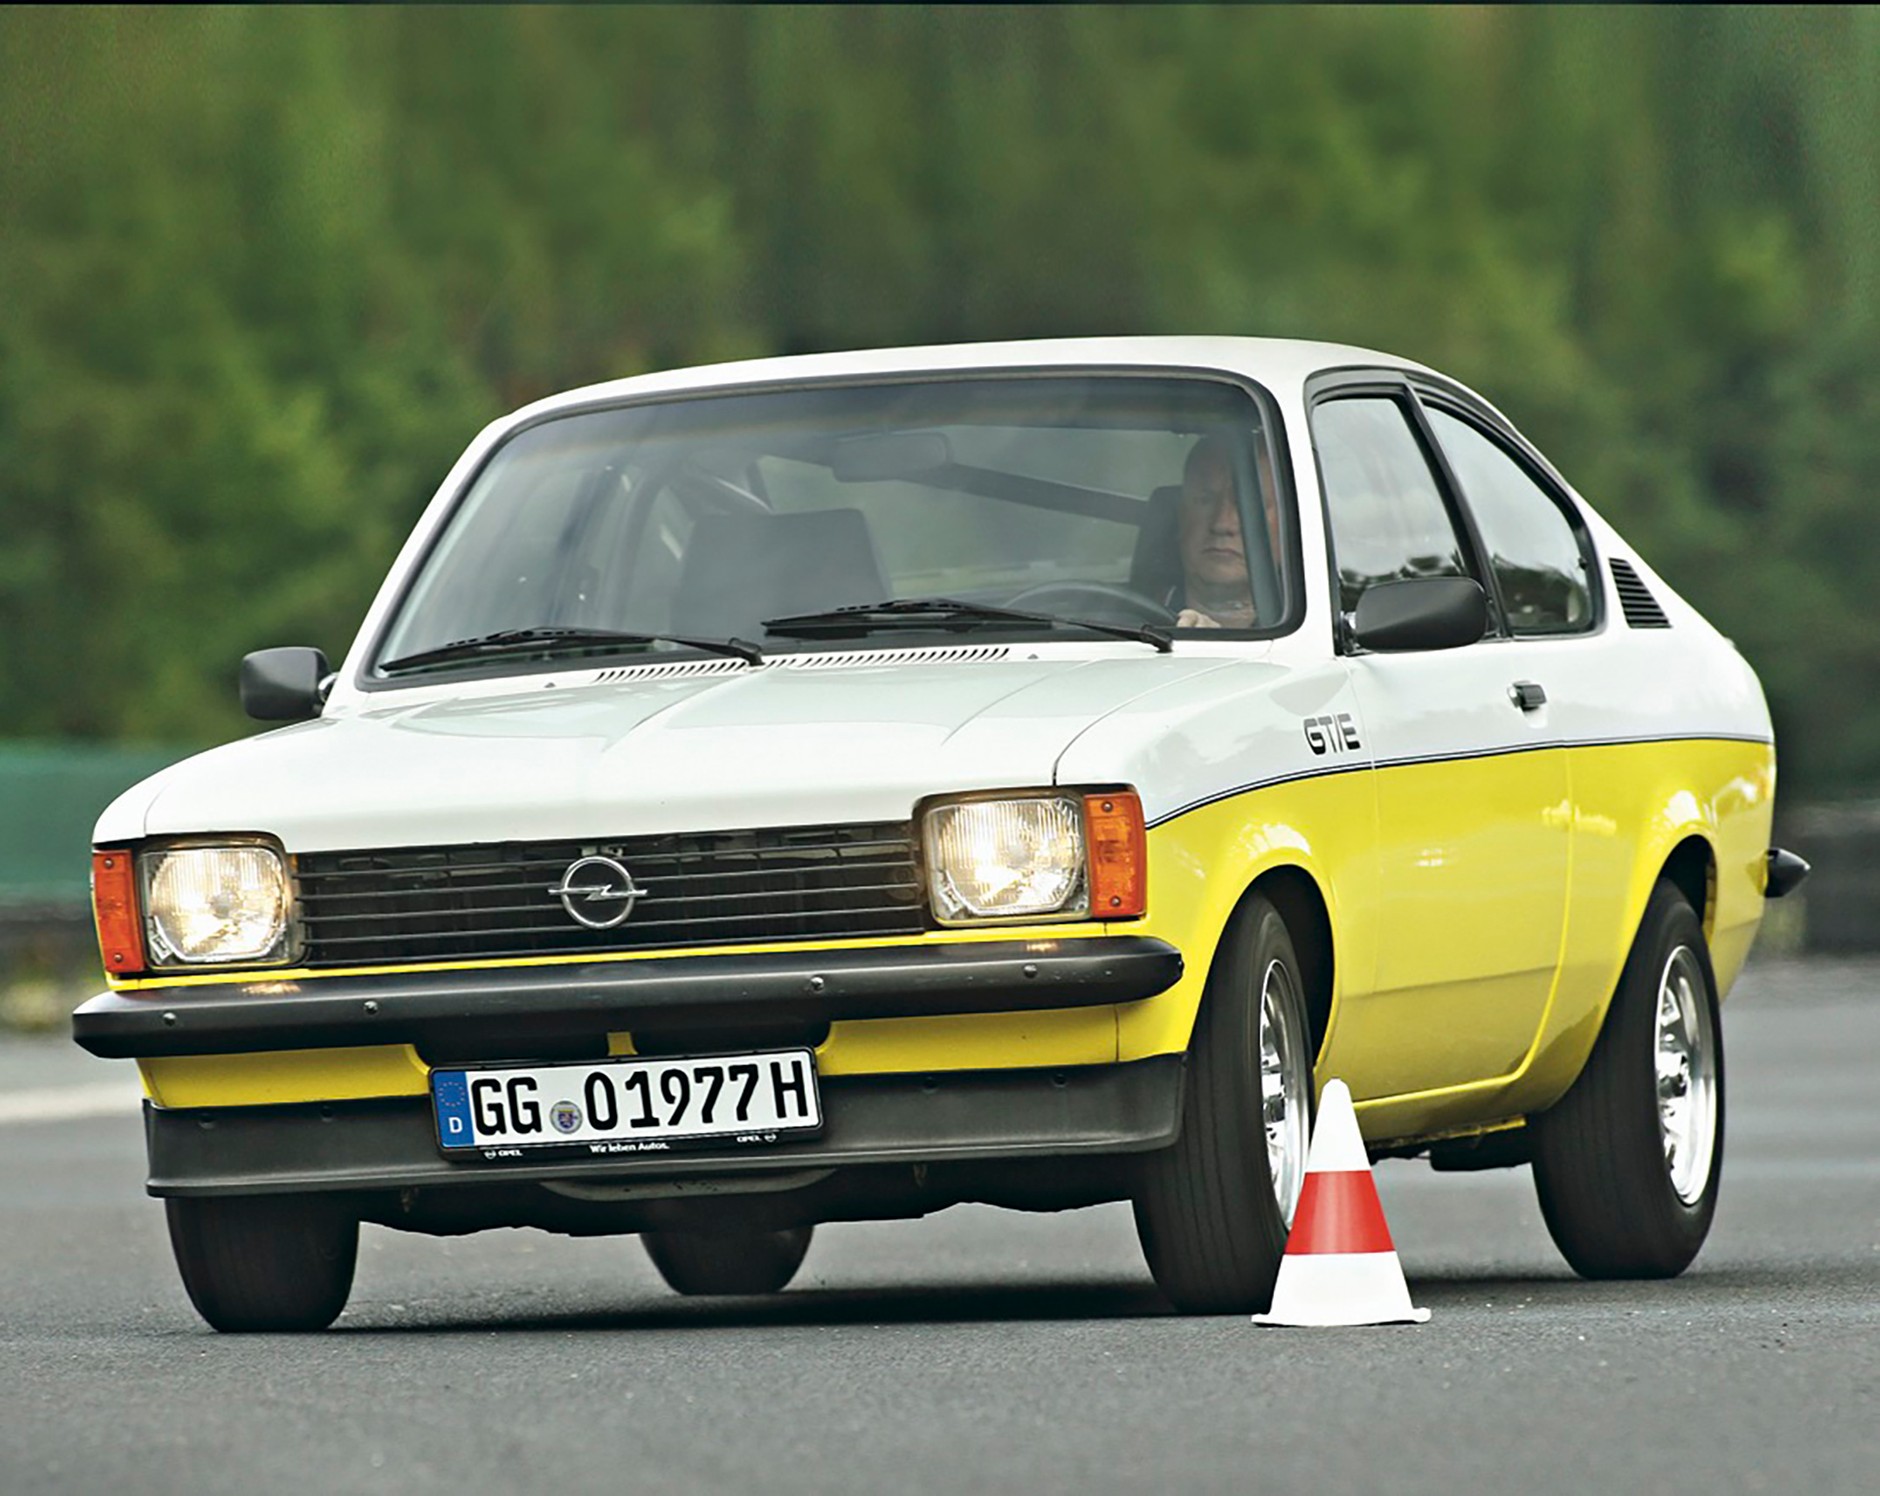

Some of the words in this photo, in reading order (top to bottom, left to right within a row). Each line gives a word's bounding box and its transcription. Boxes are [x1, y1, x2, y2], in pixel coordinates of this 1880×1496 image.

[471, 1077, 543, 1136] GG
[449, 1117, 463, 1134] D
[589, 1143, 607, 1153] Wir
[608, 1142, 637, 1152] leben
